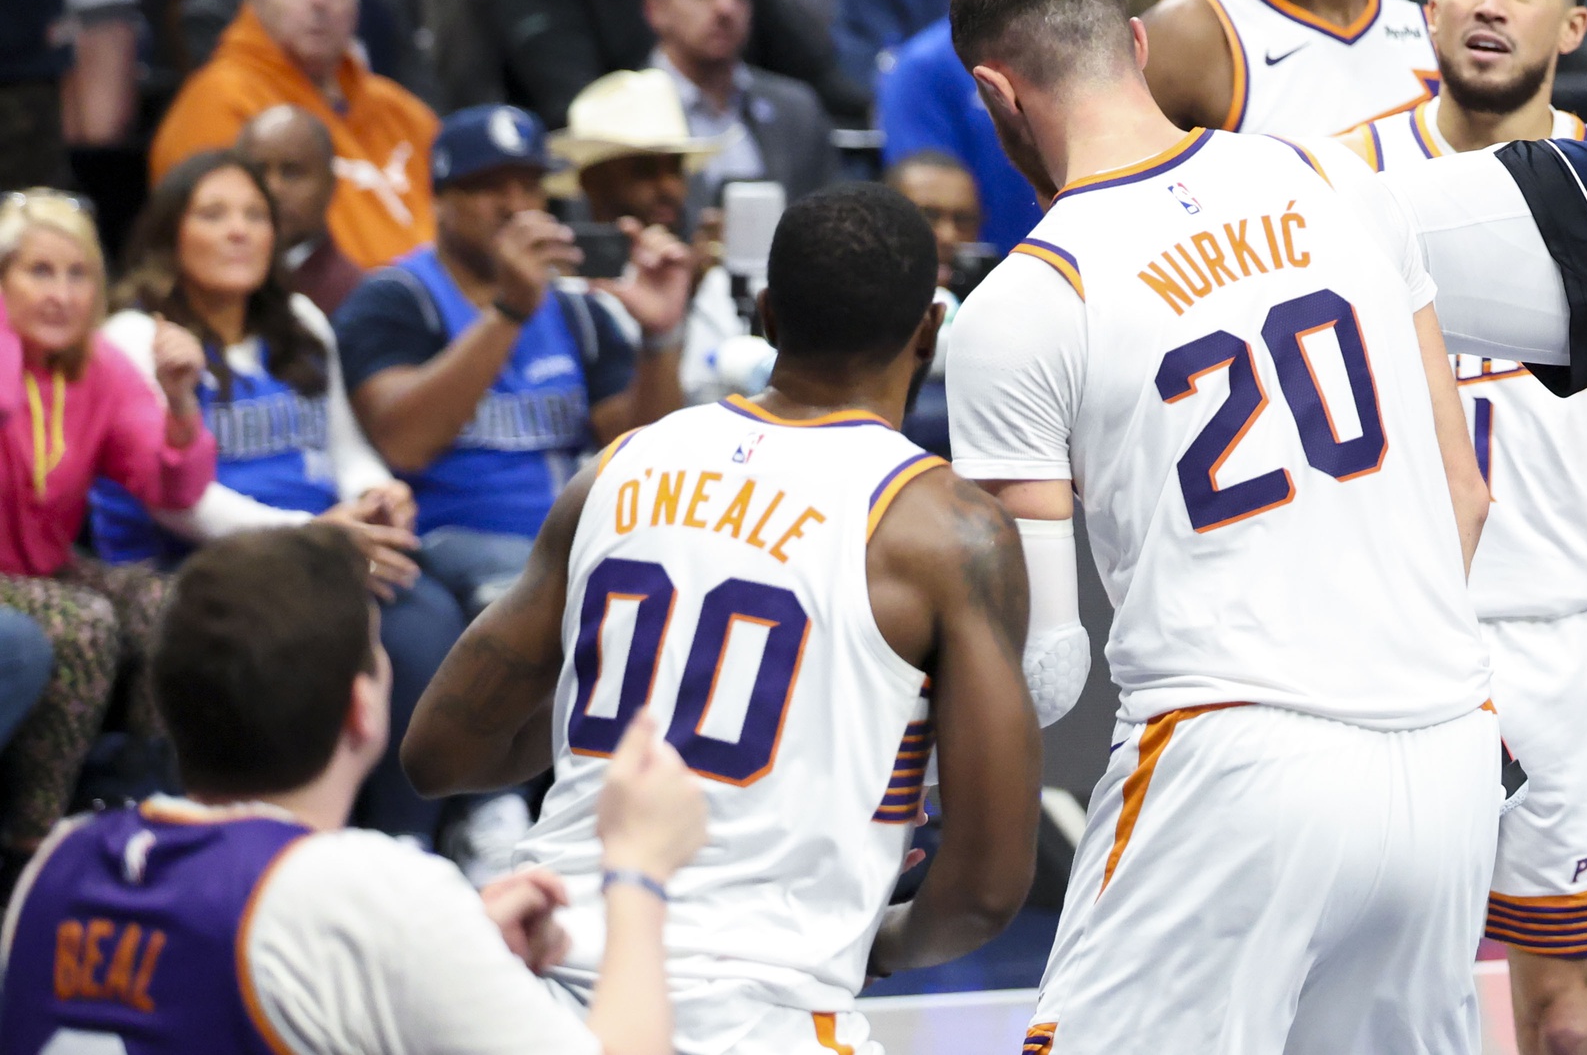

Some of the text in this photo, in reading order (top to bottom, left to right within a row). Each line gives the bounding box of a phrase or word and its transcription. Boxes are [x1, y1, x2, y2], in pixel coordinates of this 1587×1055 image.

[1136, 199, 1311, 317] NURKIĆ
[1154, 288, 1389, 534] 20
[615, 467, 828, 565] O'NEALE
[567, 556, 813, 789] 00
[52, 917, 168, 1014] BEAL
